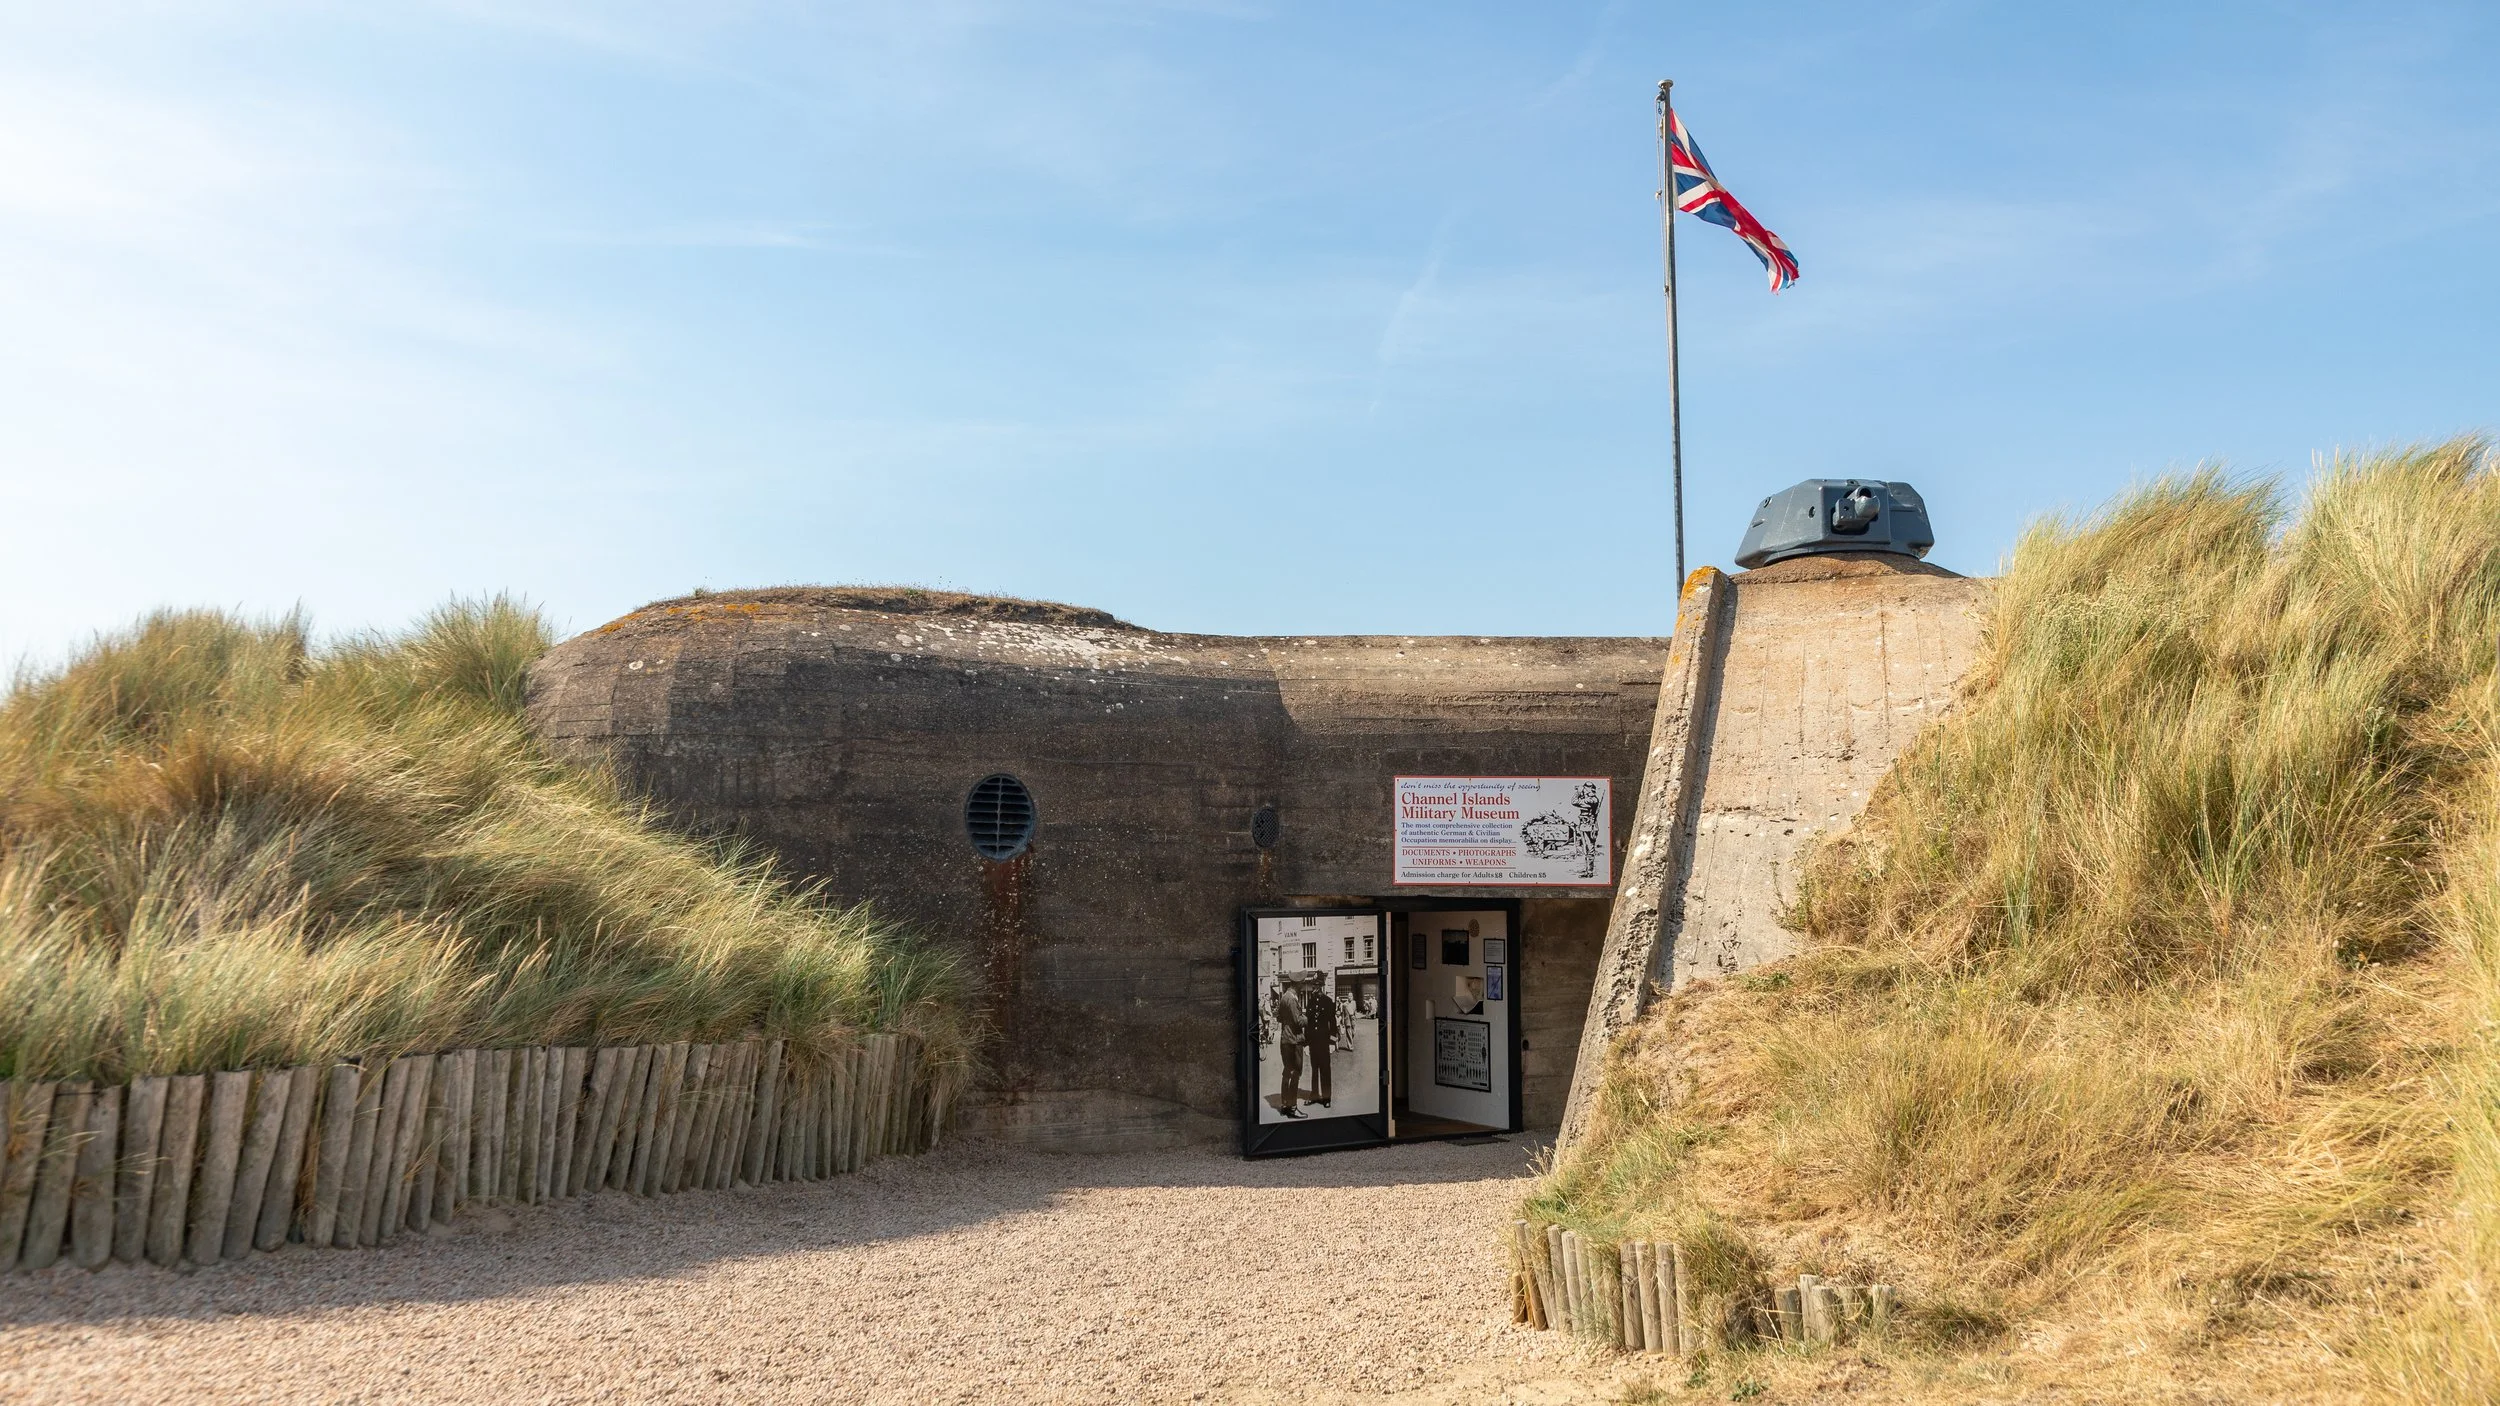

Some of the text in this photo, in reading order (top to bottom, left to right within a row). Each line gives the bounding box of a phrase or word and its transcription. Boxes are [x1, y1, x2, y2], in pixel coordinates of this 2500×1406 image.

[1458, 783, 1505, 791] opportunity
[1507, 782, 1516, 791] of
[1518, 783, 1541, 791] seeing
[1402, 792, 1511, 805] Channel Islands
[1402, 806, 1520, 821] Military Museum
[1458, 849, 1517, 857] PHOTOGRAPHS
[1437, 871, 1460, 879] charge
